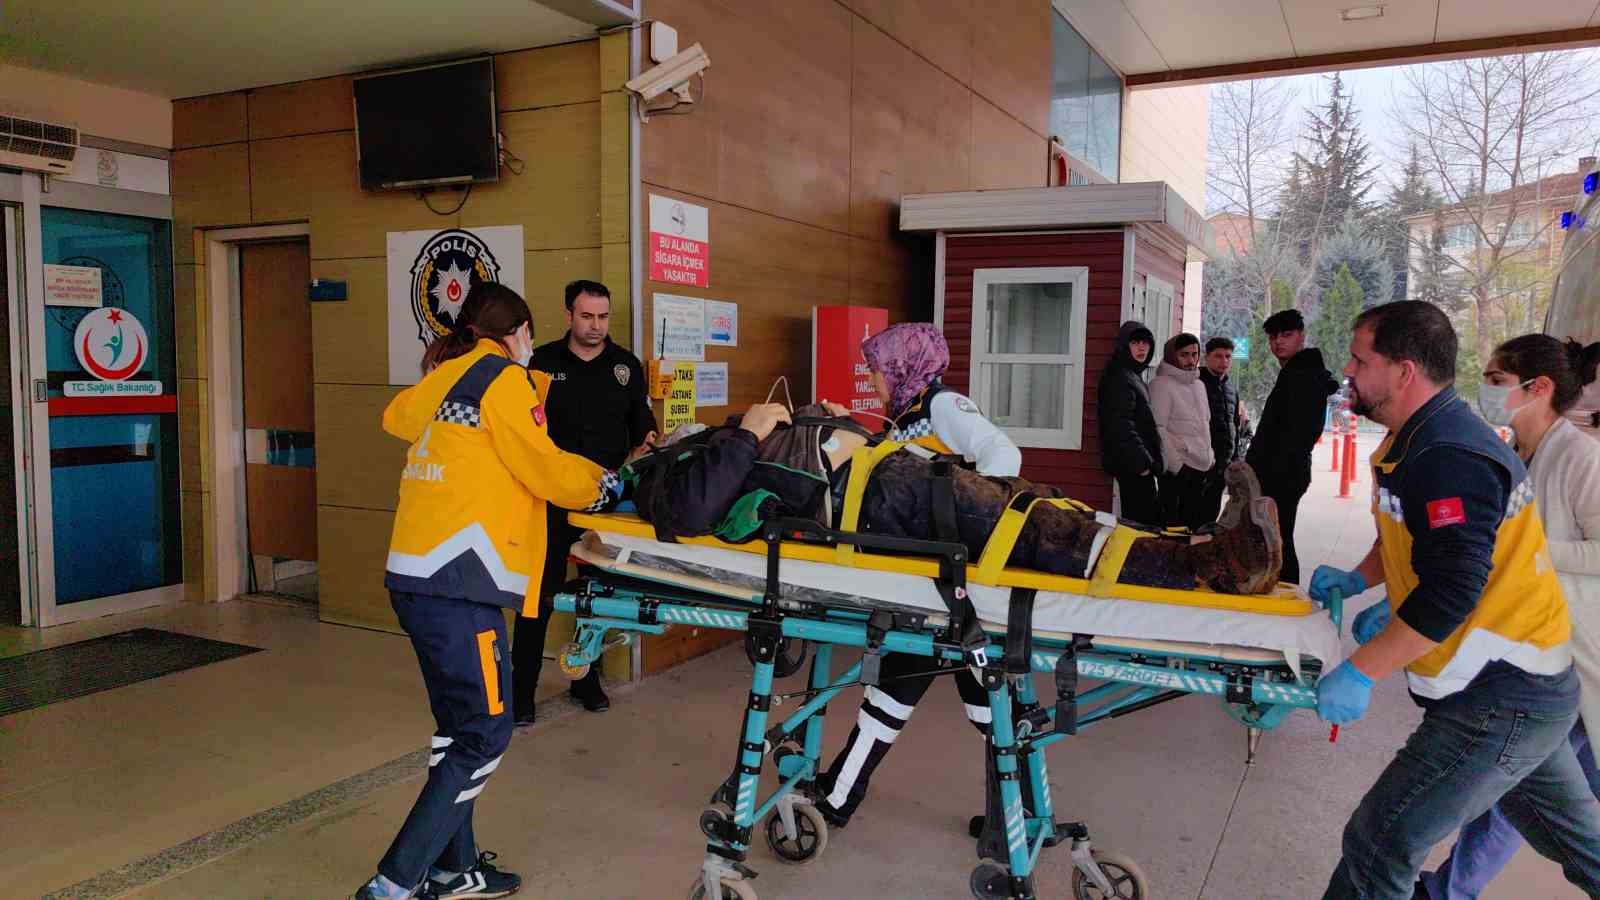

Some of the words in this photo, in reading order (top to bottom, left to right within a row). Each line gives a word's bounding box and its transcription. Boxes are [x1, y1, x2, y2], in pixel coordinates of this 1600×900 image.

[659, 236, 670, 248] BU
[671, 239, 700, 254] ALANDA
[655, 249, 682, 266] SİGARA
[663, 270, 697, 285] YASAKTIR
[671, 389, 692, 400] ASTANE
